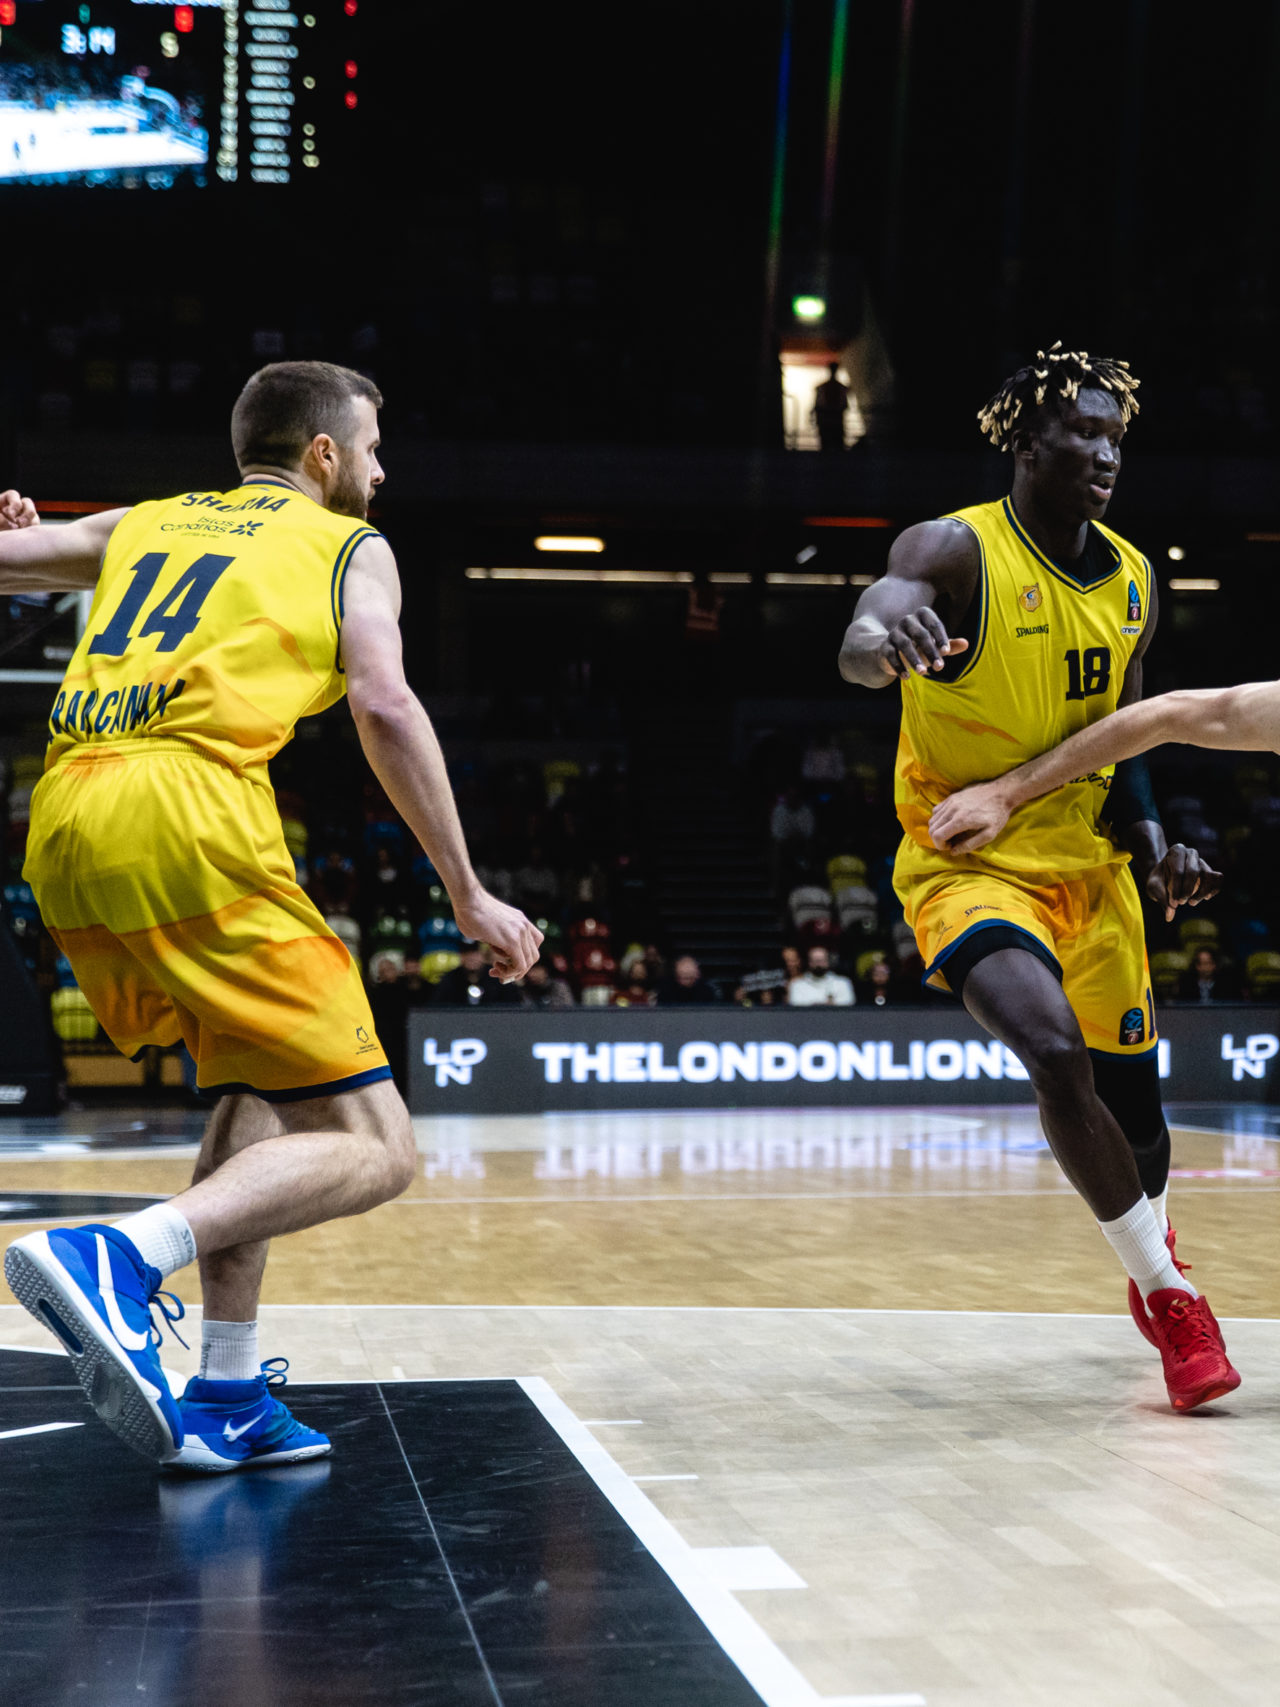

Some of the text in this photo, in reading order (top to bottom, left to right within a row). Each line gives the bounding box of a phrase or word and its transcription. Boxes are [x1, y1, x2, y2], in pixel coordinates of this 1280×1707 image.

[87, 552, 236, 657] 14
[1016, 623, 1049, 638] SPALDING
[1063, 647, 1112, 701] 18
